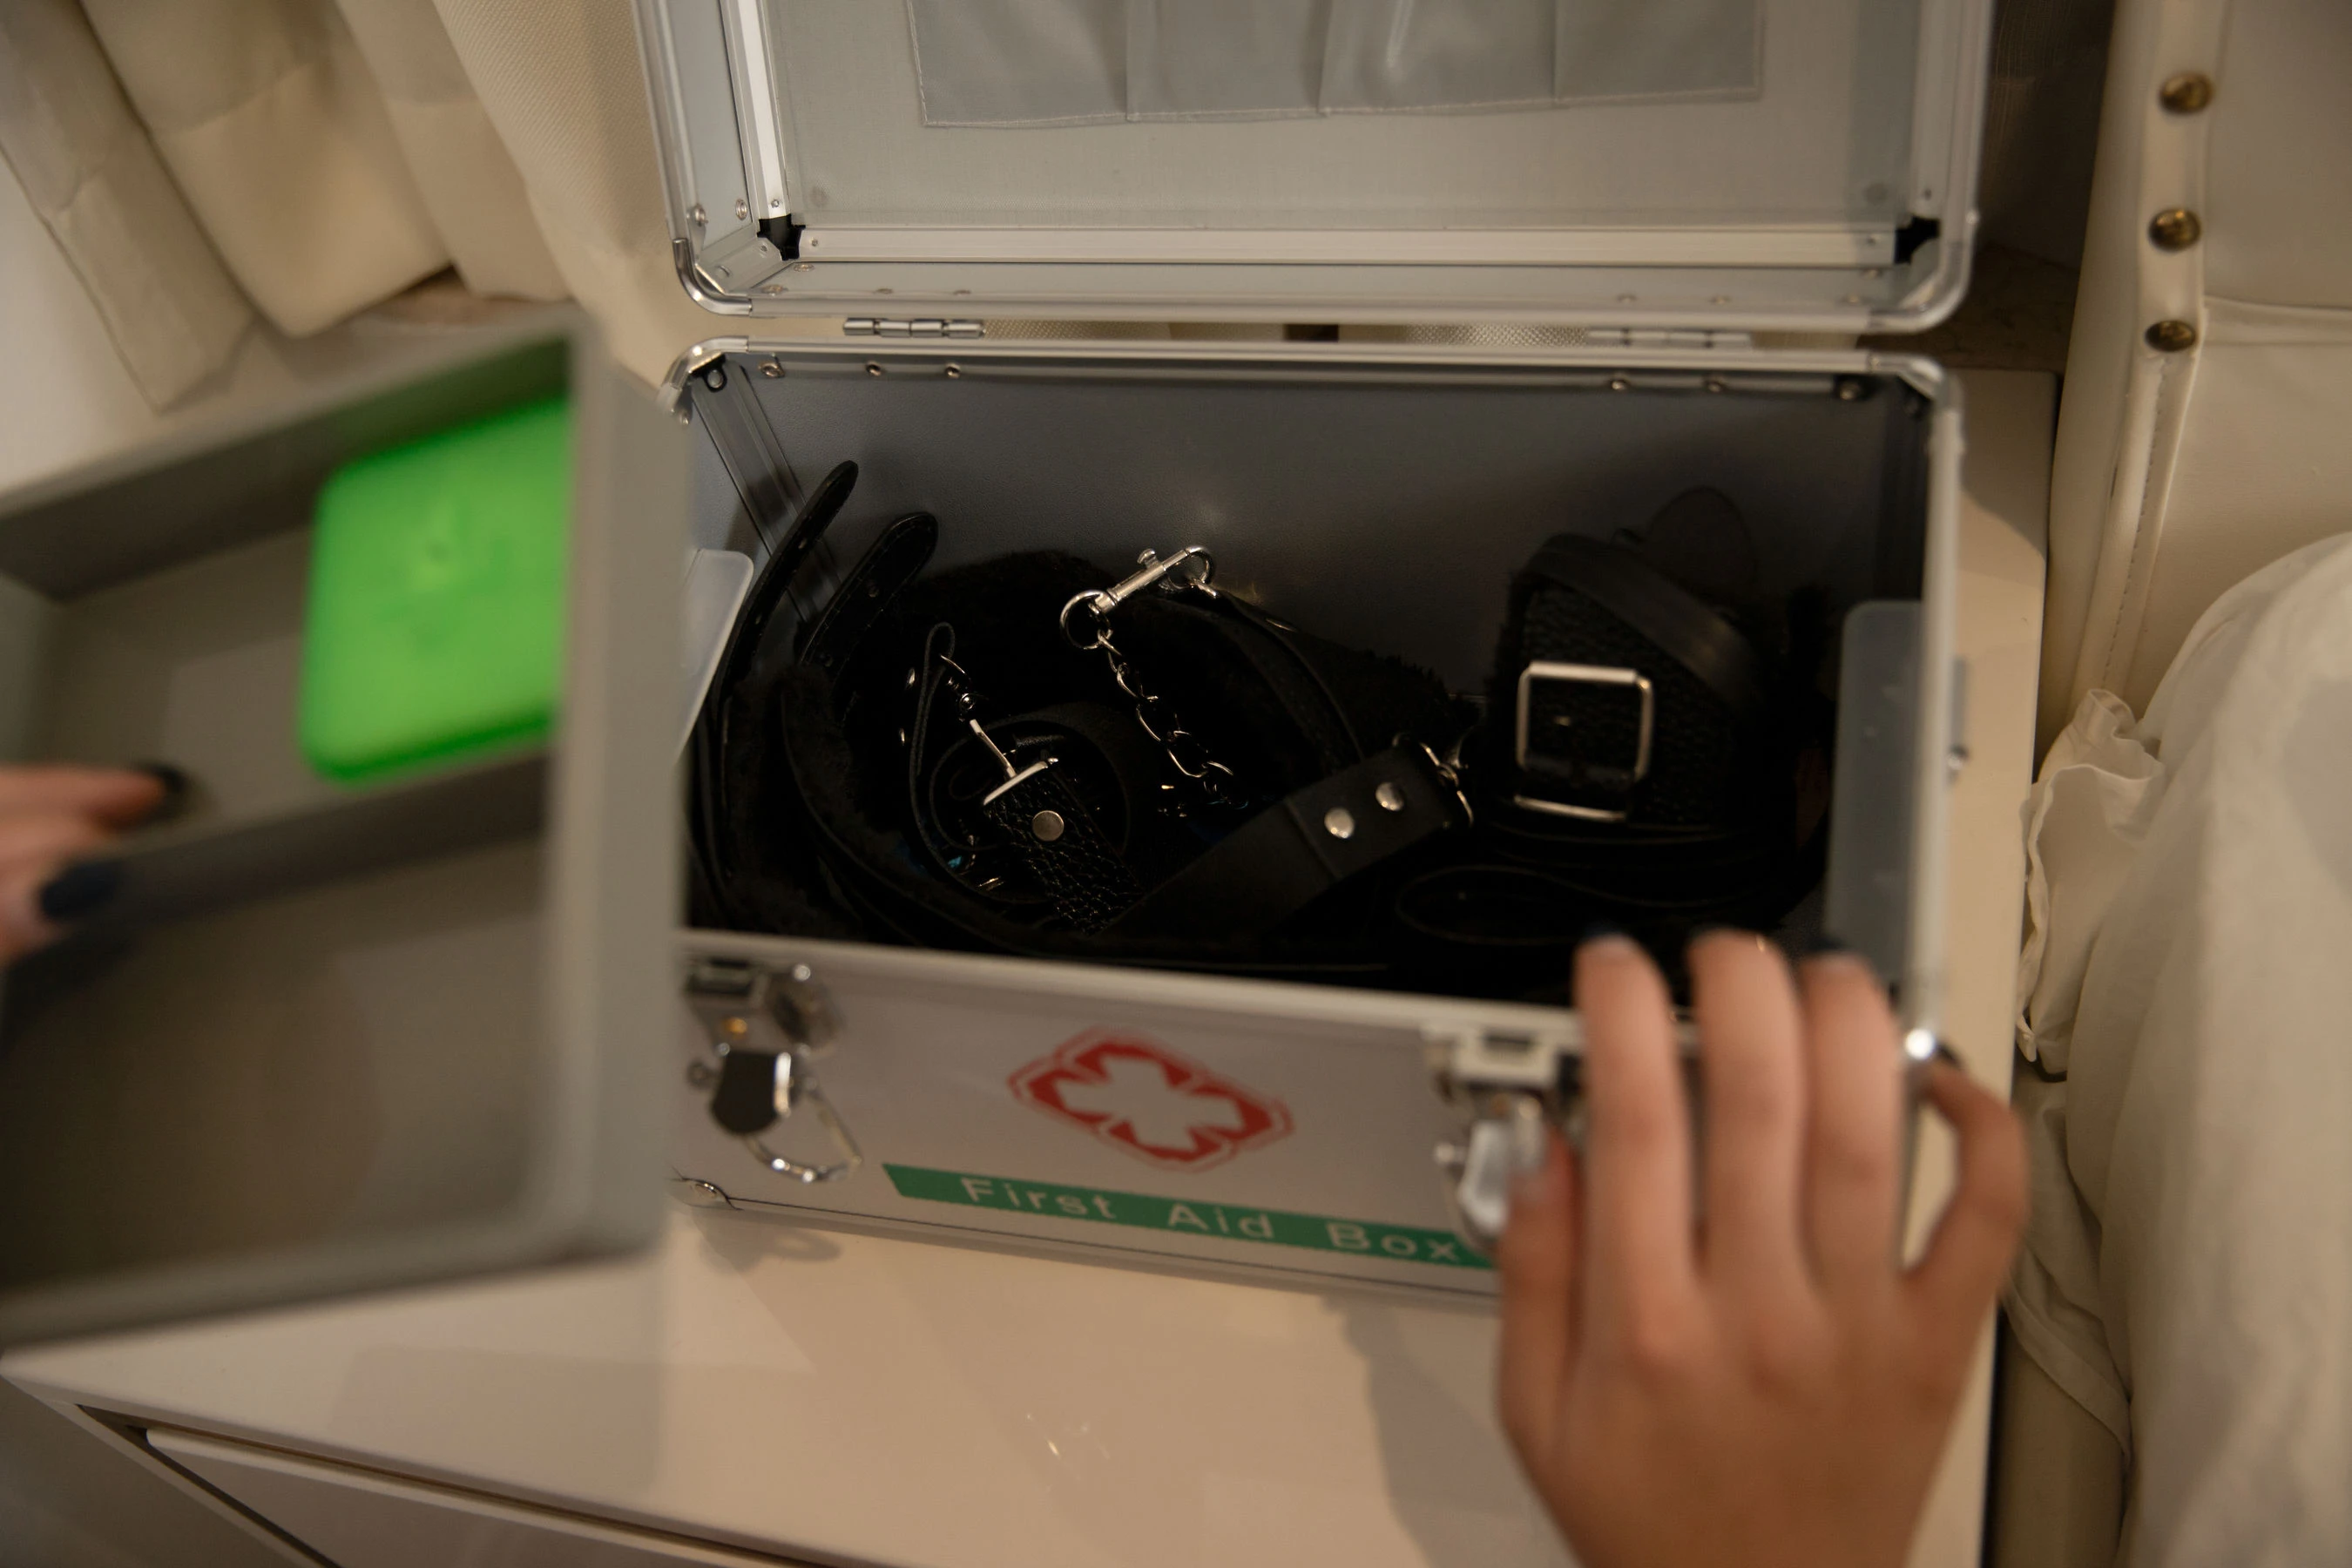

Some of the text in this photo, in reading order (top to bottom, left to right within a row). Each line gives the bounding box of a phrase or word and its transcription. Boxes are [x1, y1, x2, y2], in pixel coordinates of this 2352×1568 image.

[960, 1175, 1461, 1262] First Aid Box
